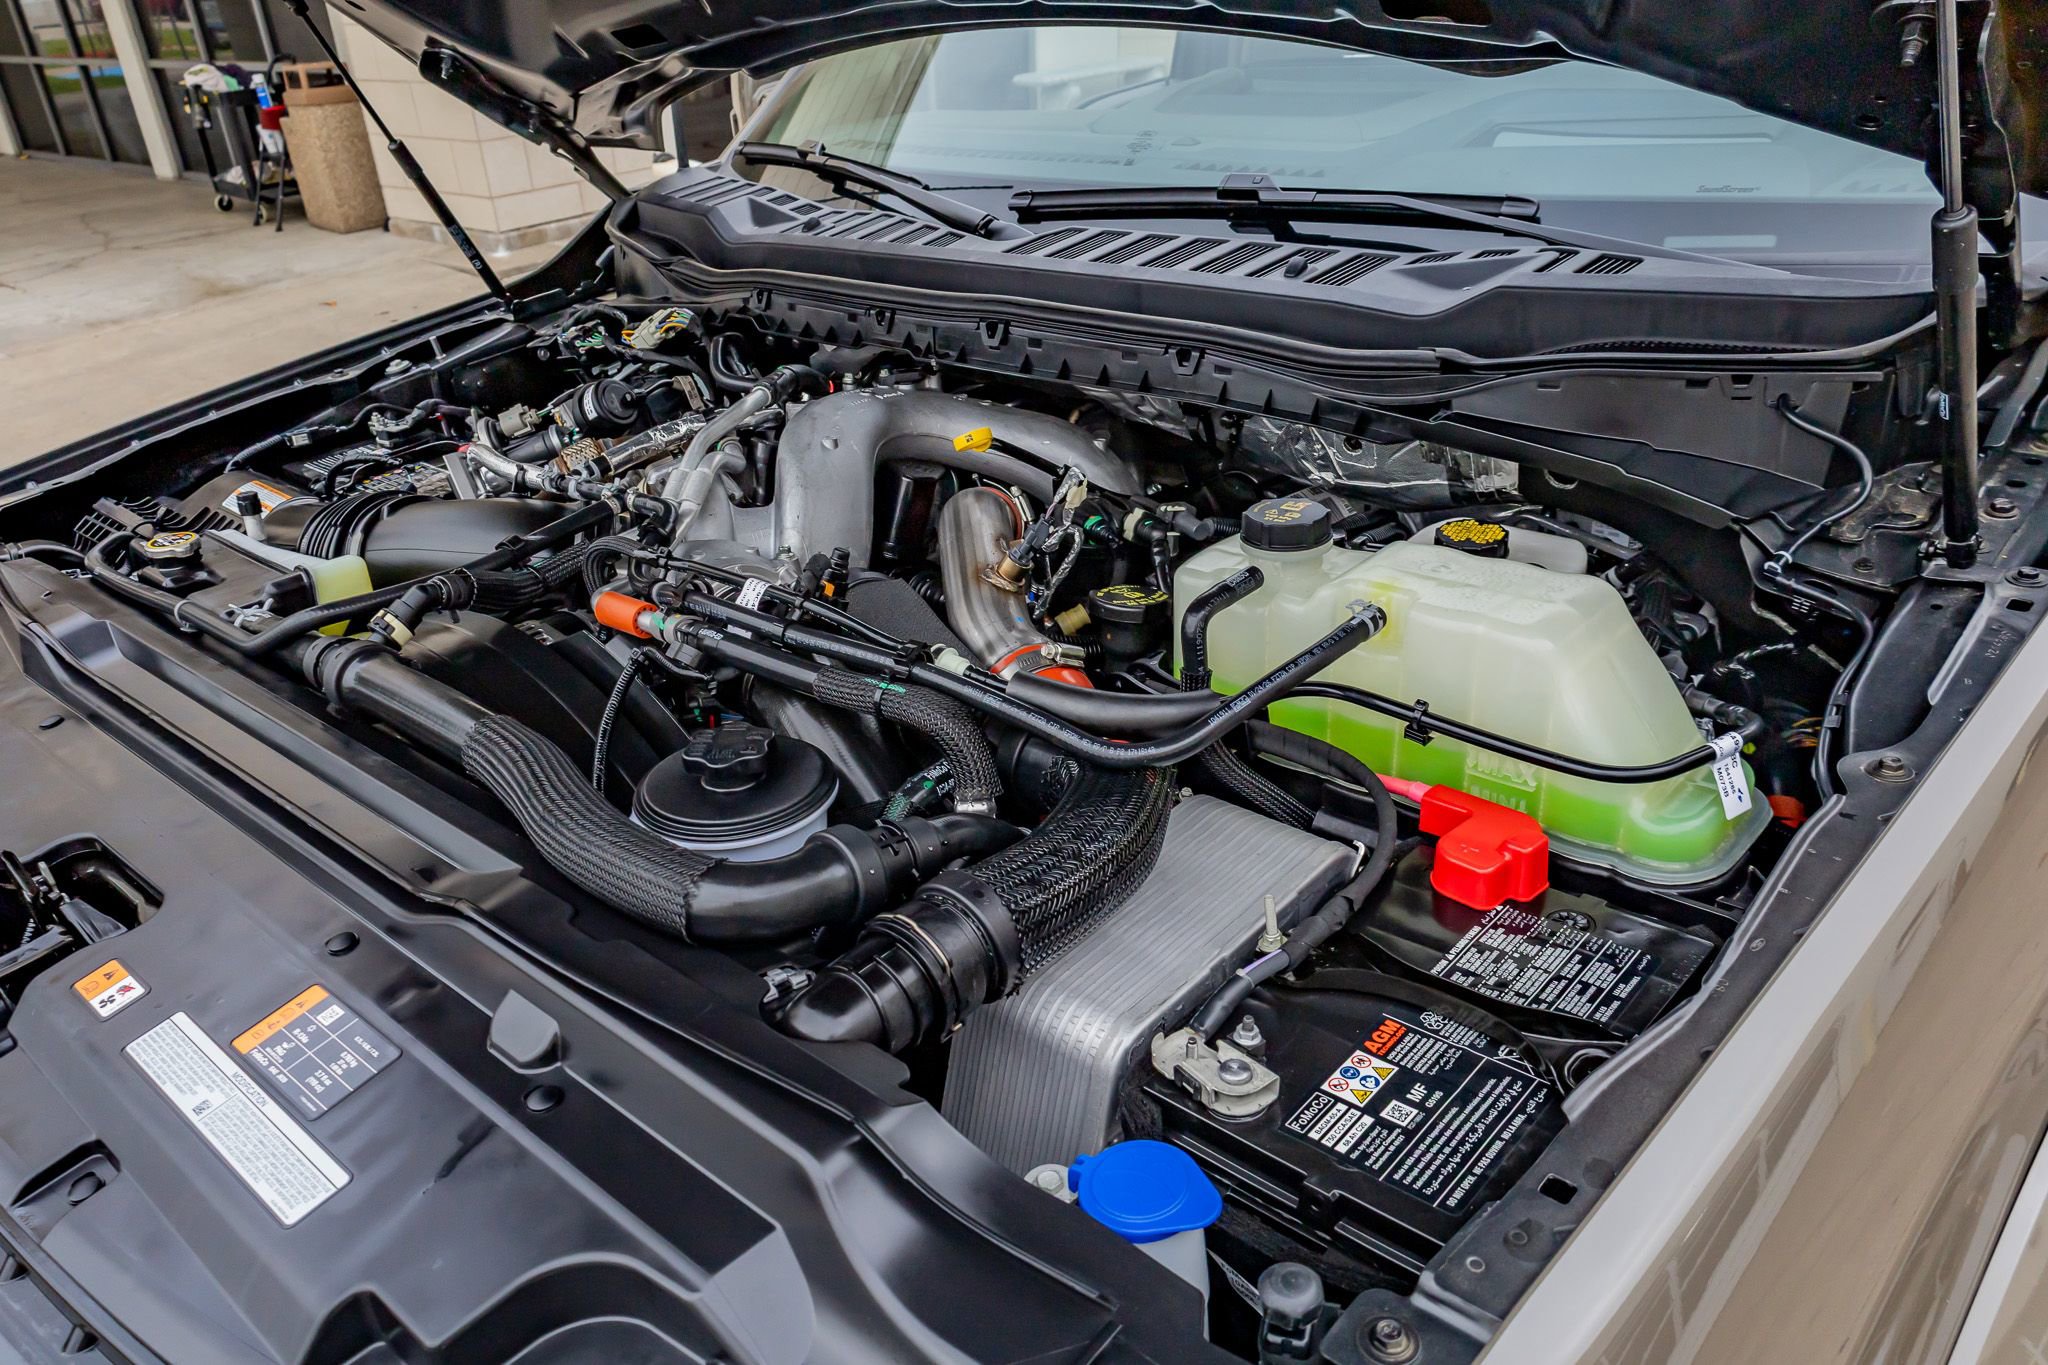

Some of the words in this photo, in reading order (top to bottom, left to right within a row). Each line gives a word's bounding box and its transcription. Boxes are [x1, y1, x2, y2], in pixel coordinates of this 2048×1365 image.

[1364, 1019, 1400, 1053] AGM
[1377, 1026, 1407, 1056] TECHNOLOGY
[231, 1071, 268, 1107] MODIFICATION
[1406, 1082, 1428, 1103] MF
[1291, 1096, 1328, 1132] FoMoCo
[1325, 1133, 1337, 1144] 750
[1334, 1111, 1358, 1135] CCA/SAE
[1355, 1121, 1368, 1133] C20
[1364, 1155, 1377, 1167] Ford
[1372, 1145, 1386, 1158] Motor
[1382, 1128, 1402, 1146] Company,
[1452, 1187, 1466, 1200] NOT
[1460, 1175, 1478, 1190] OPEN.
[1477, 1156, 1491, 1169] PAS
[1485, 1140, 1506, 1159] OUVRIR.
[1511, 1114, 1528, 1128] ABRA.
